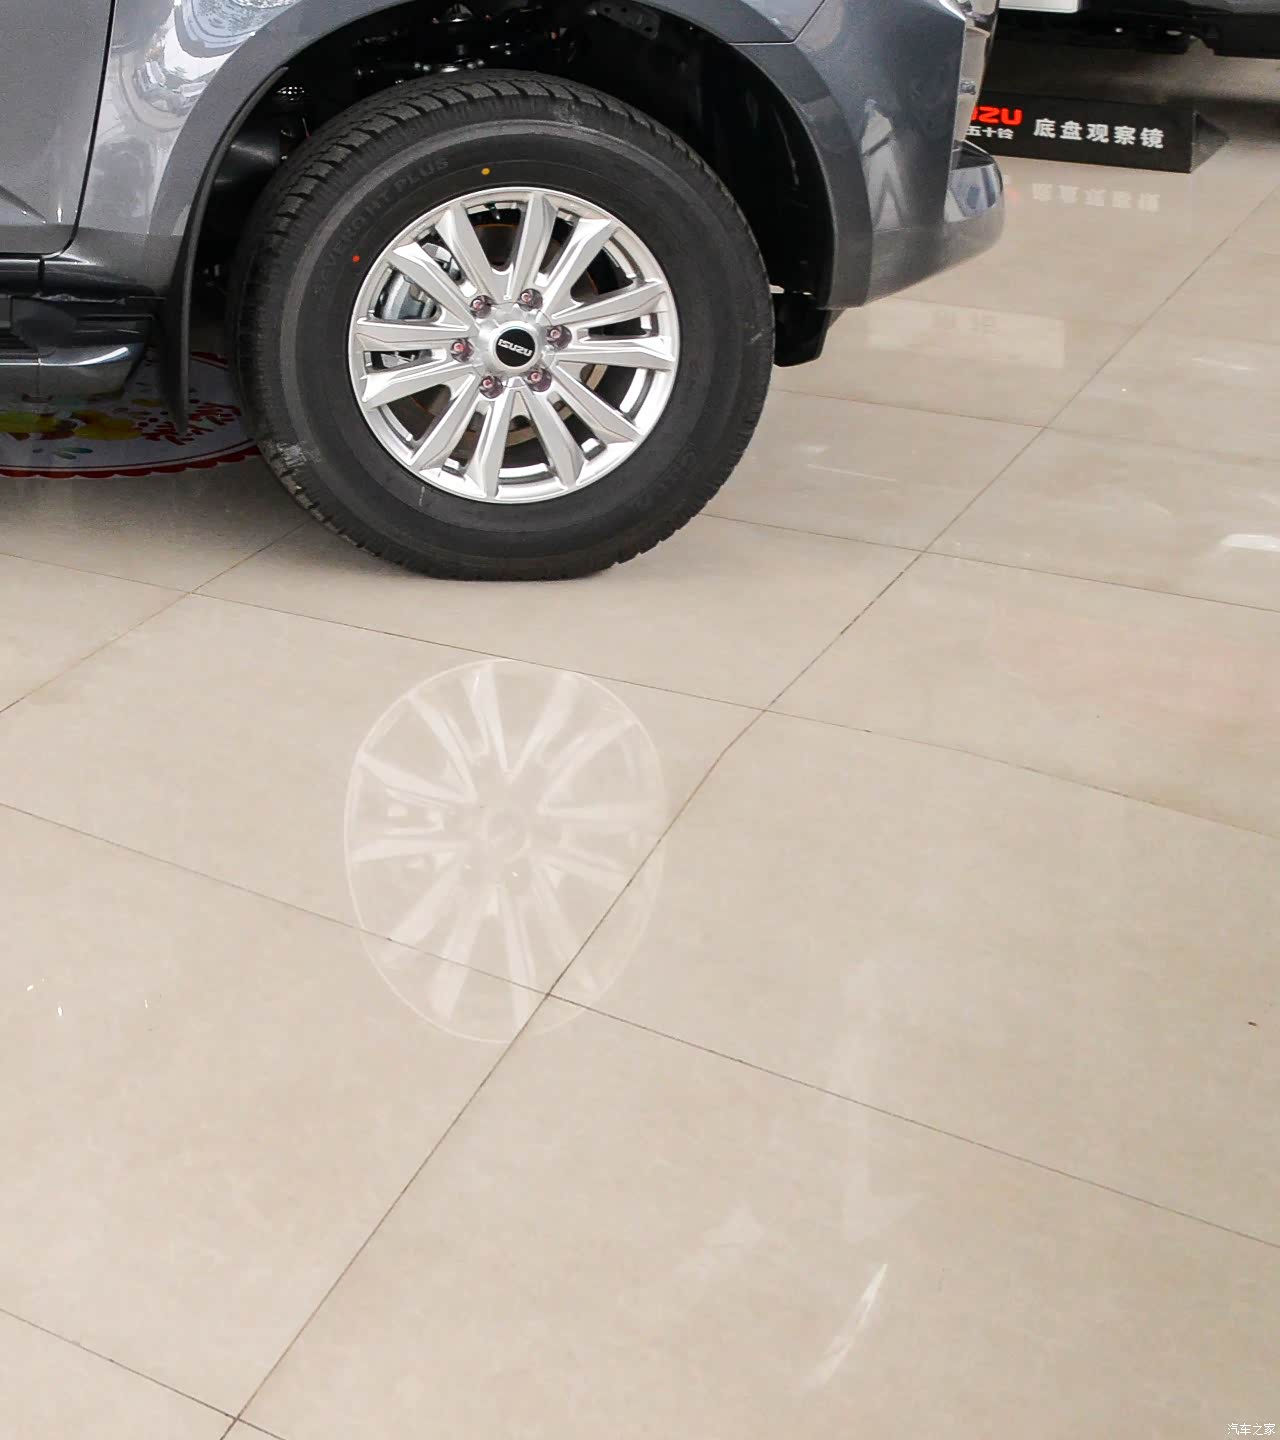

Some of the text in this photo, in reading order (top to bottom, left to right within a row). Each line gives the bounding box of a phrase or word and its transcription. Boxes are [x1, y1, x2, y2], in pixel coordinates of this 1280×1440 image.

[1033, 118, 1164, 149] 底盘观察镜
[394, 157, 449, 193] PLUS
[497, 338, 533, 357] ISUZU
